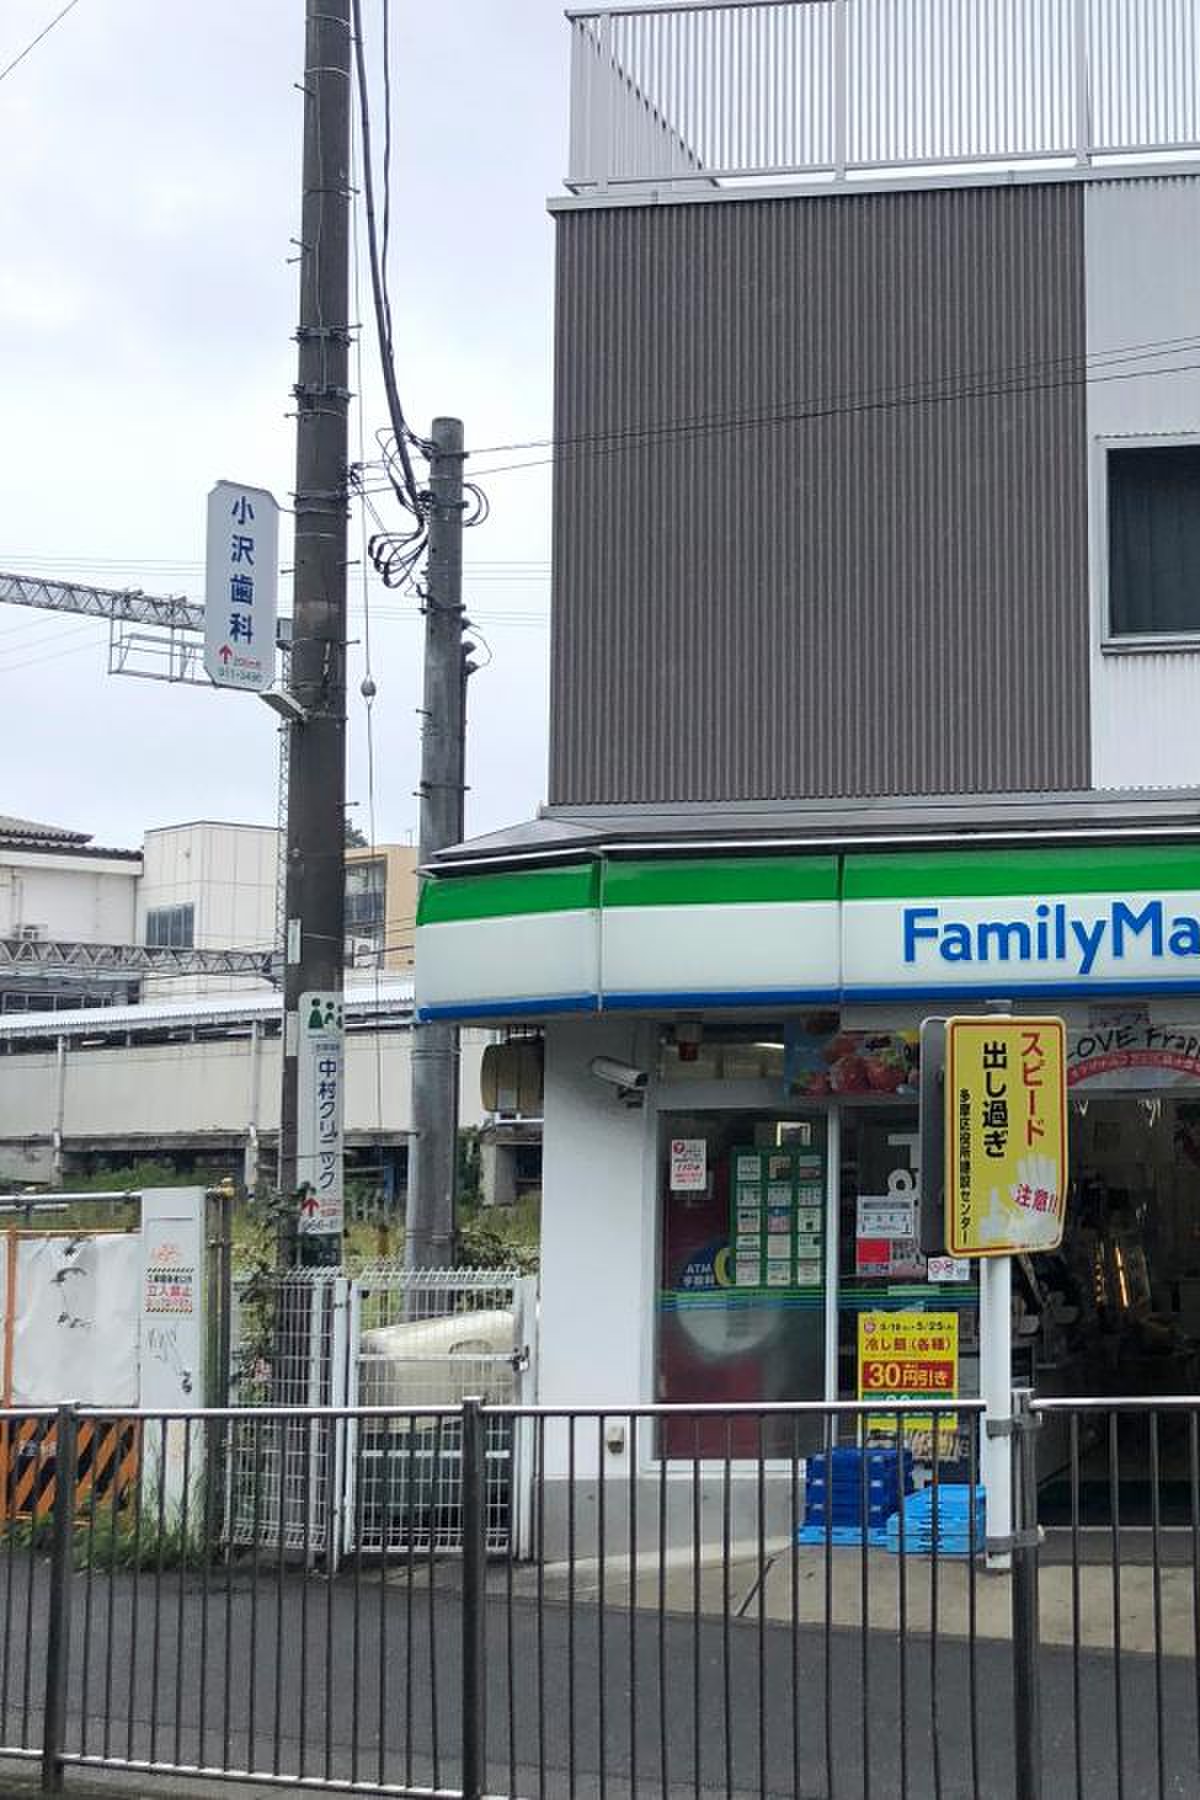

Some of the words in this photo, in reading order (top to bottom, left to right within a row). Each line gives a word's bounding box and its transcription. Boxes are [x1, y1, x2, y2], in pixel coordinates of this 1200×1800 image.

[229, 495, 255, 645] 小沢歯科
[318, 1059, 338, 1189] 中村クリニック
[982, 1041, 1009, 1158] 出し過ぎ
[1020, 1032, 1045, 1146] スピード
[868, 1363, 950, 1388] 30円引き
